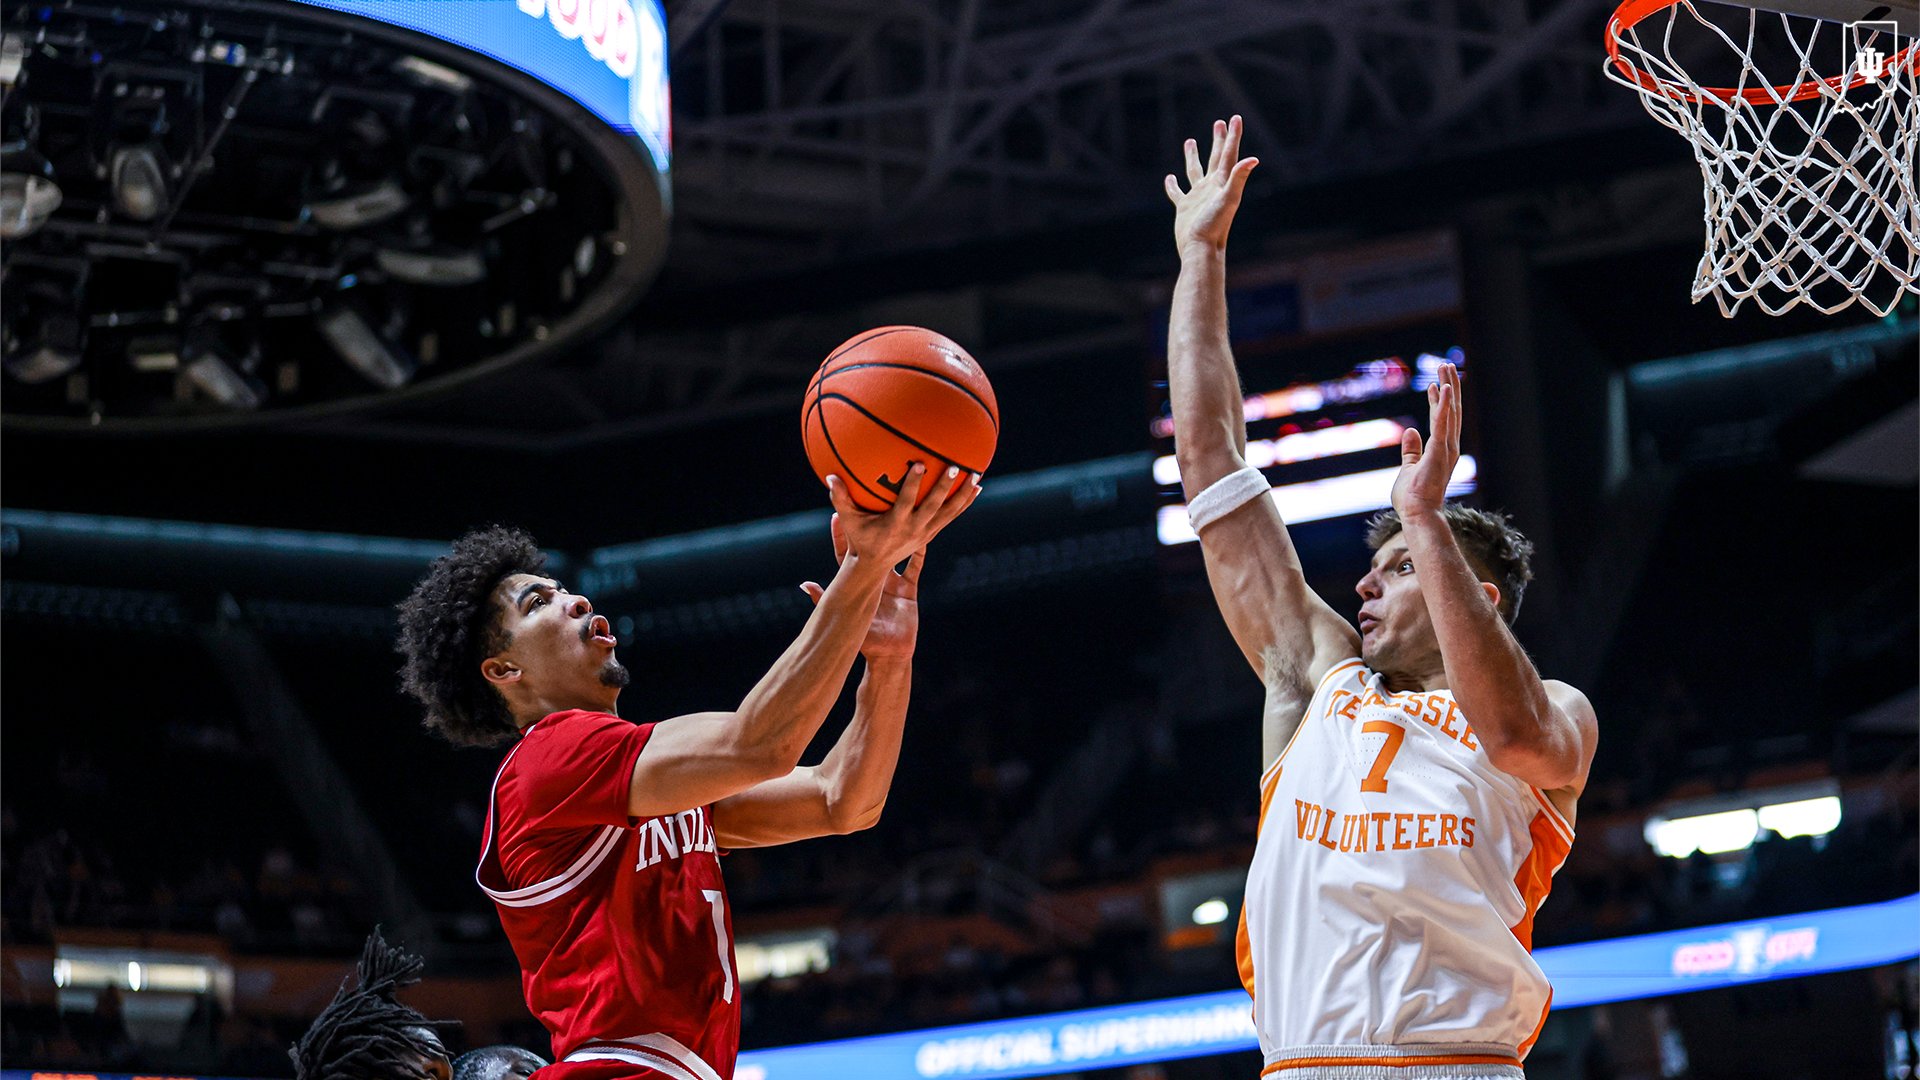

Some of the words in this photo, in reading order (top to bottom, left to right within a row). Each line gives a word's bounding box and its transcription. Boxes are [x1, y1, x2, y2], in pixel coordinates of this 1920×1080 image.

[1360, 720, 1406, 794] 7
[1295, 798, 1476, 854] VOLUNTEERS
[701, 889, 734, 1004] 1
[916, 1028, 1055, 1077] OFFICIAL
